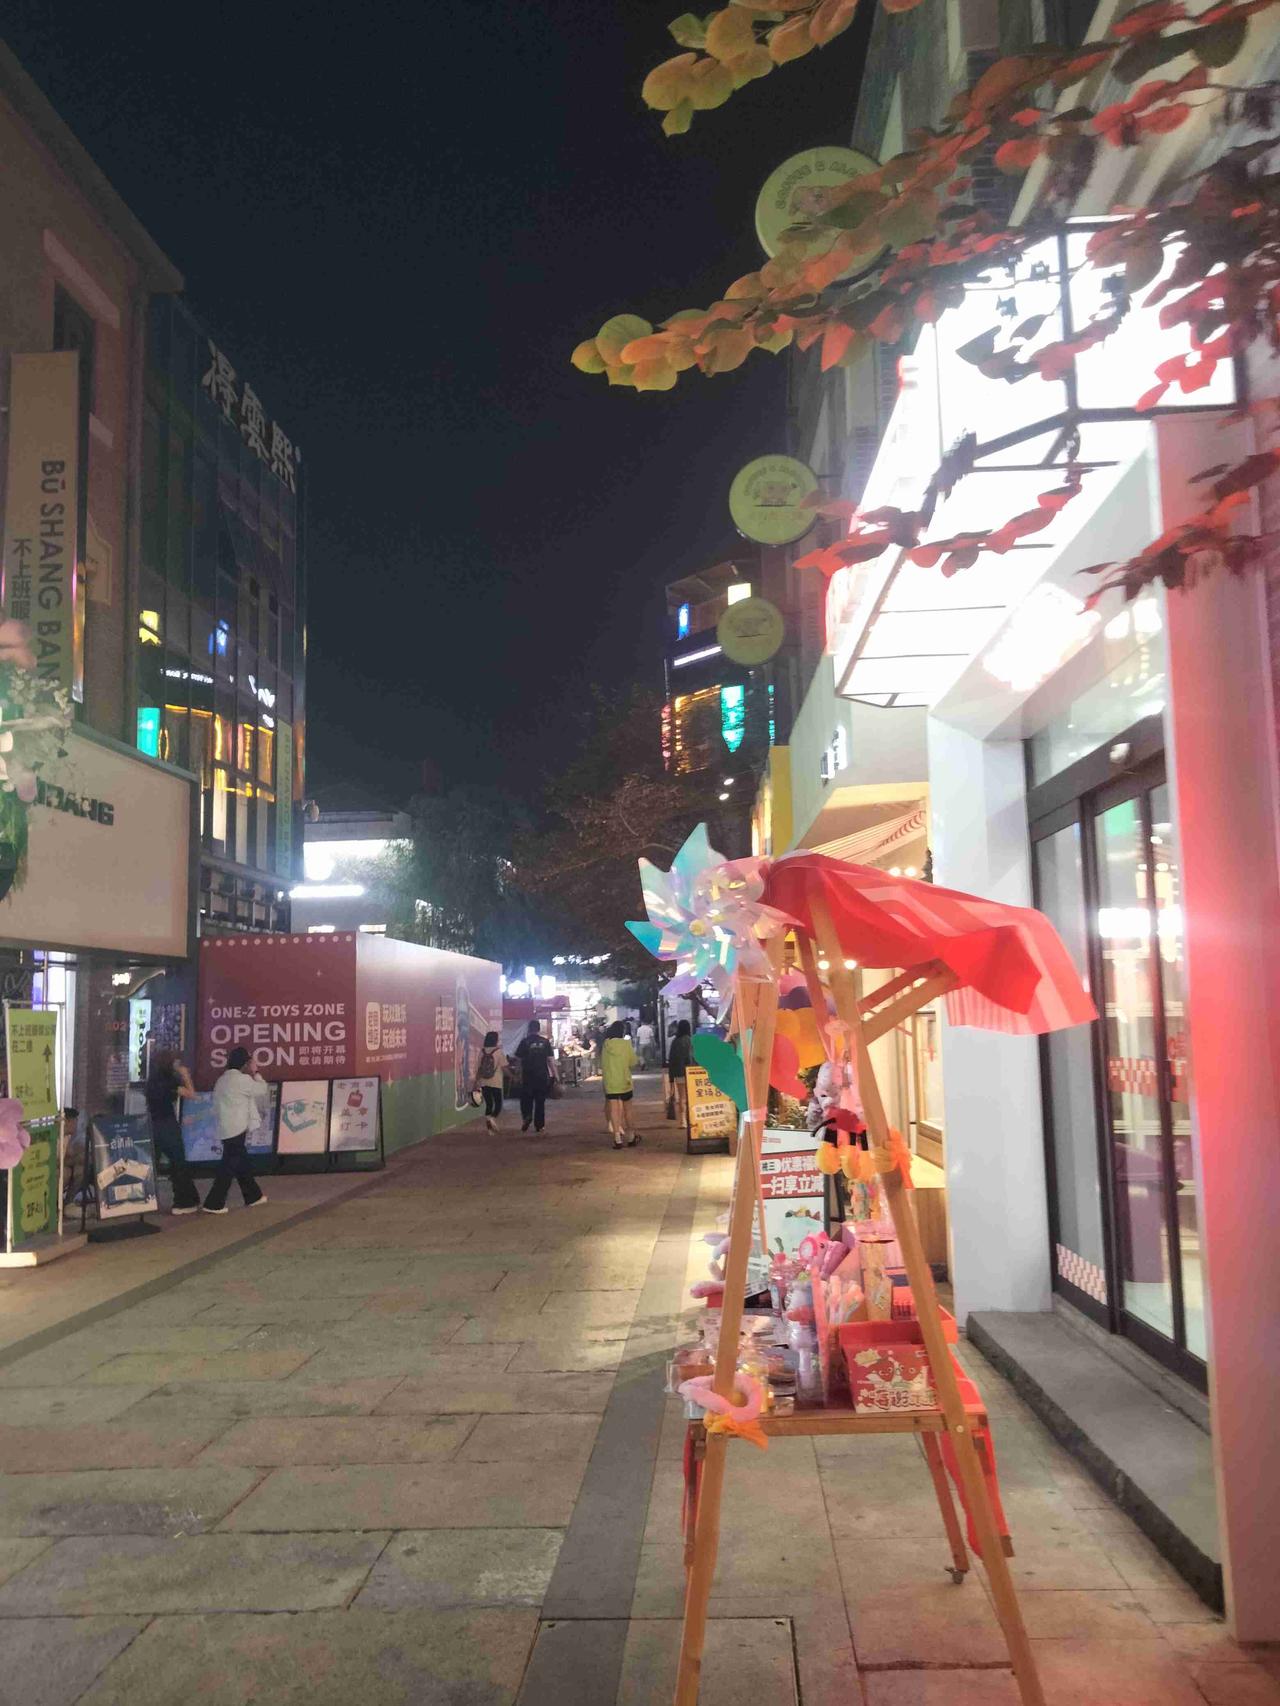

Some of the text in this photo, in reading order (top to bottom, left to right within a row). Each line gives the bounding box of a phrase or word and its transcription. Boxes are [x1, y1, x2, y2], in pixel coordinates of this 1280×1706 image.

[38, 503, 65, 610] SHANG
[211, 1002, 345, 1019] ONE-Z TOYS ZONE
[210, 1021, 346, 1045] OPENING
[210, 1046, 295, 1068] SON
[299, 1044, 346, 1055] 即将开幕
[299, 1055, 346, 1066] 敬请期待
[781, 1155, 818, 1173] 优惠福
[761, 1173, 825, 1196] 一扫享立减
